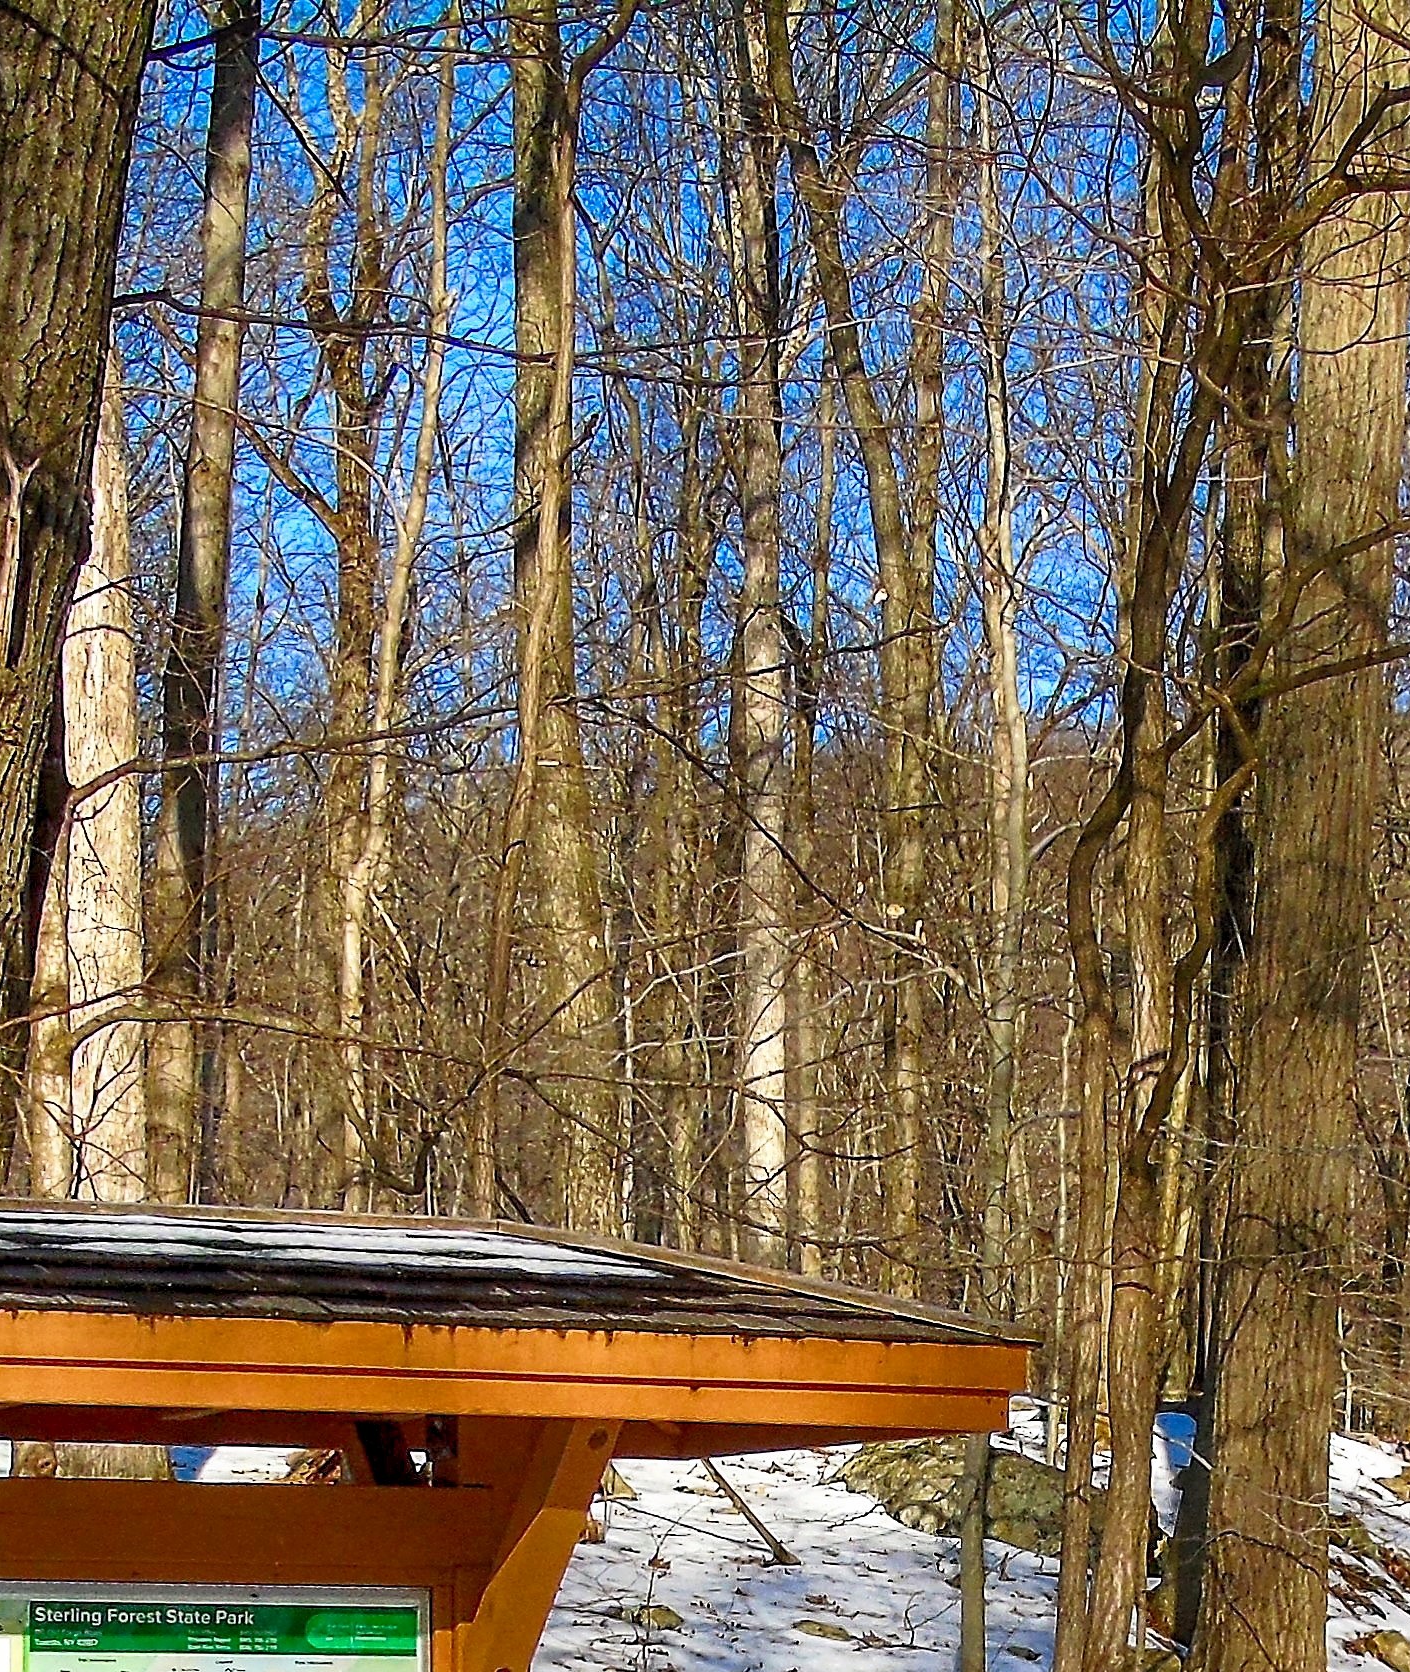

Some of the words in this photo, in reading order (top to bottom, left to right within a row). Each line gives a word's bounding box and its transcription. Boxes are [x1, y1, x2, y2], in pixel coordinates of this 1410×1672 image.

[34, 1607, 102, 1626] Sterling
[107, 1609, 161, 1624] Forest
[166, 1609, 211, 1625] State
[215, 1610, 255, 1625] Park
